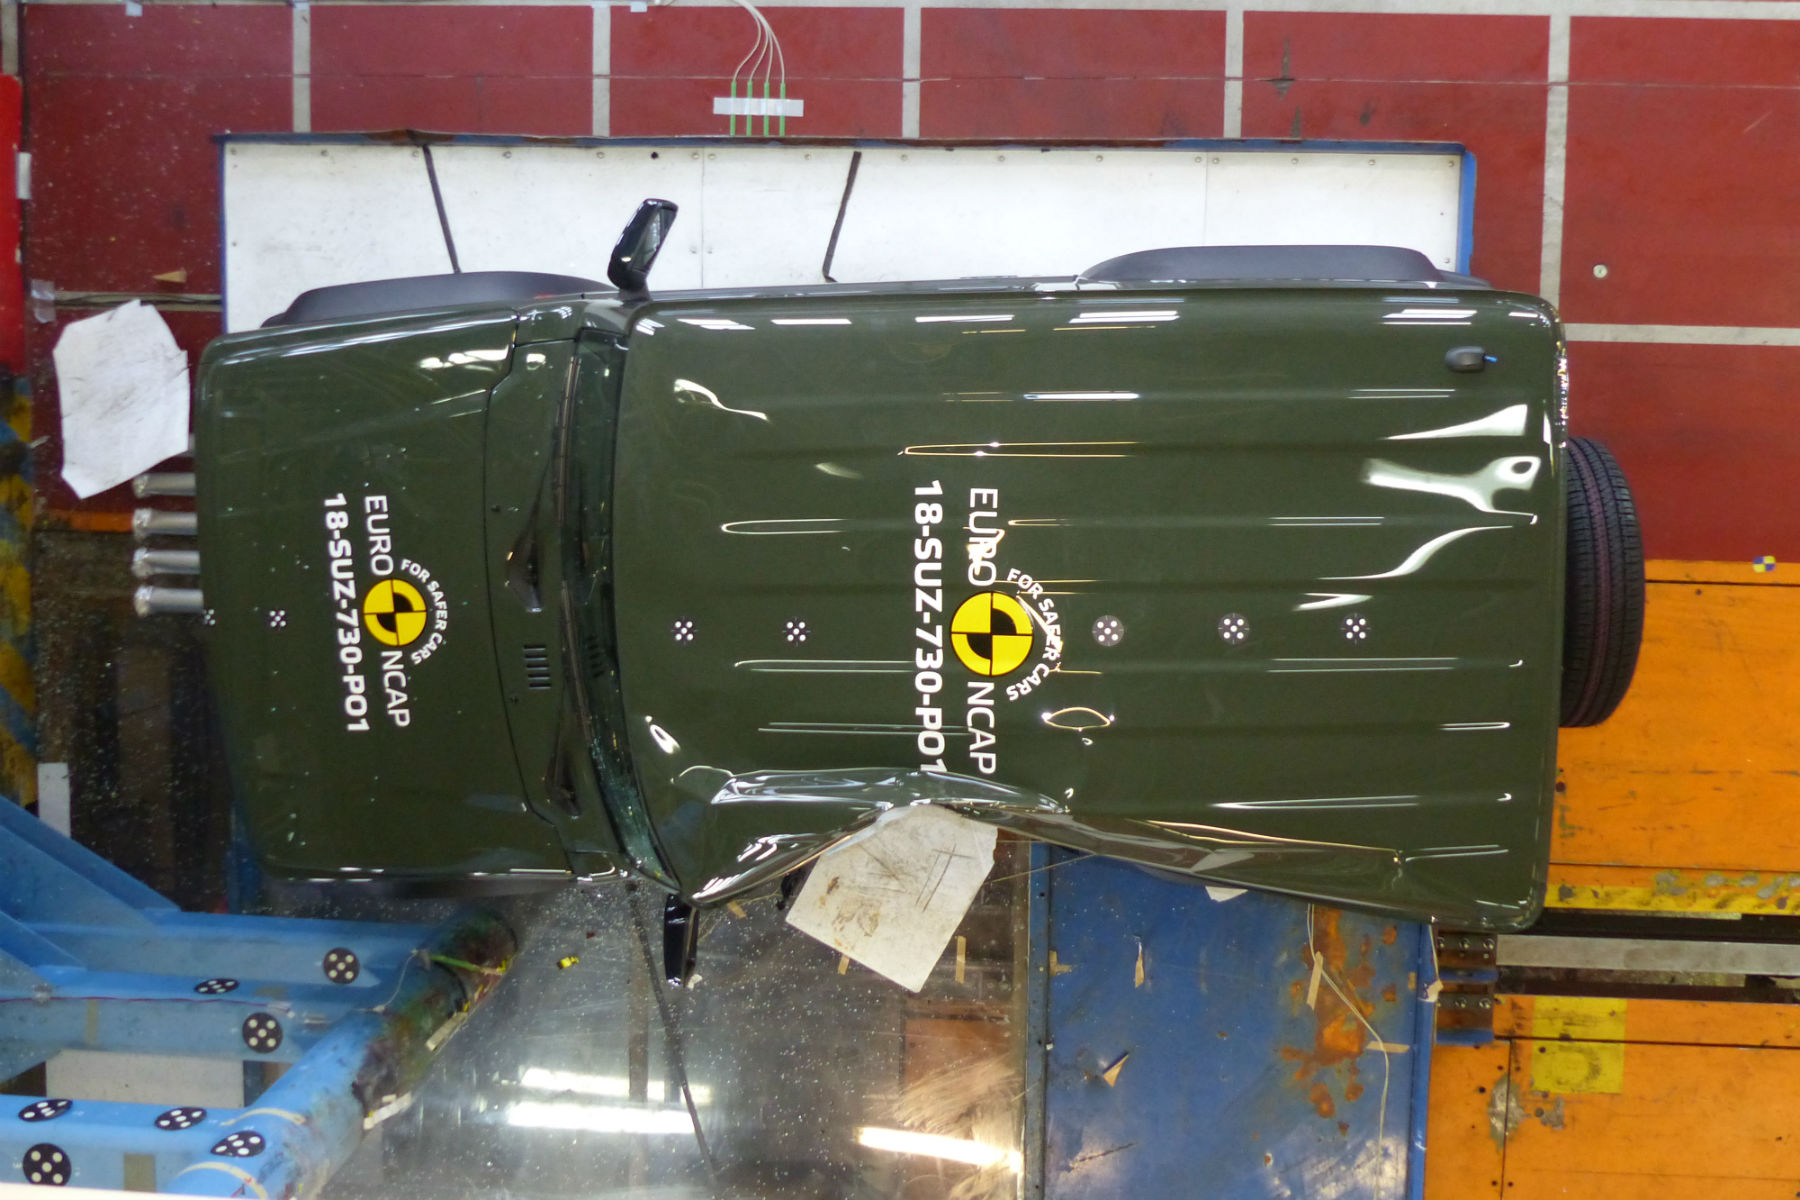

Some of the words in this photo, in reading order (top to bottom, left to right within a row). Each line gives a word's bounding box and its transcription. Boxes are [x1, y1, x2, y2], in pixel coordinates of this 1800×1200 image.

[364, 495, 394, 576] EURO
[967, 488, 998, 586] EURO
[400, 558, 430, 583] FOR
[1006, 568, 1044, 600] FOR
[427, 580, 448, 631] SAFER
[1038, 598, 1062, 661] SAFER
[410, 632, 443, 665] CARS
[381, 650, 411, 727] NCAP
[1006, 662, 1049, 701] CARS
[966, 681, 997, 775] NCAP
